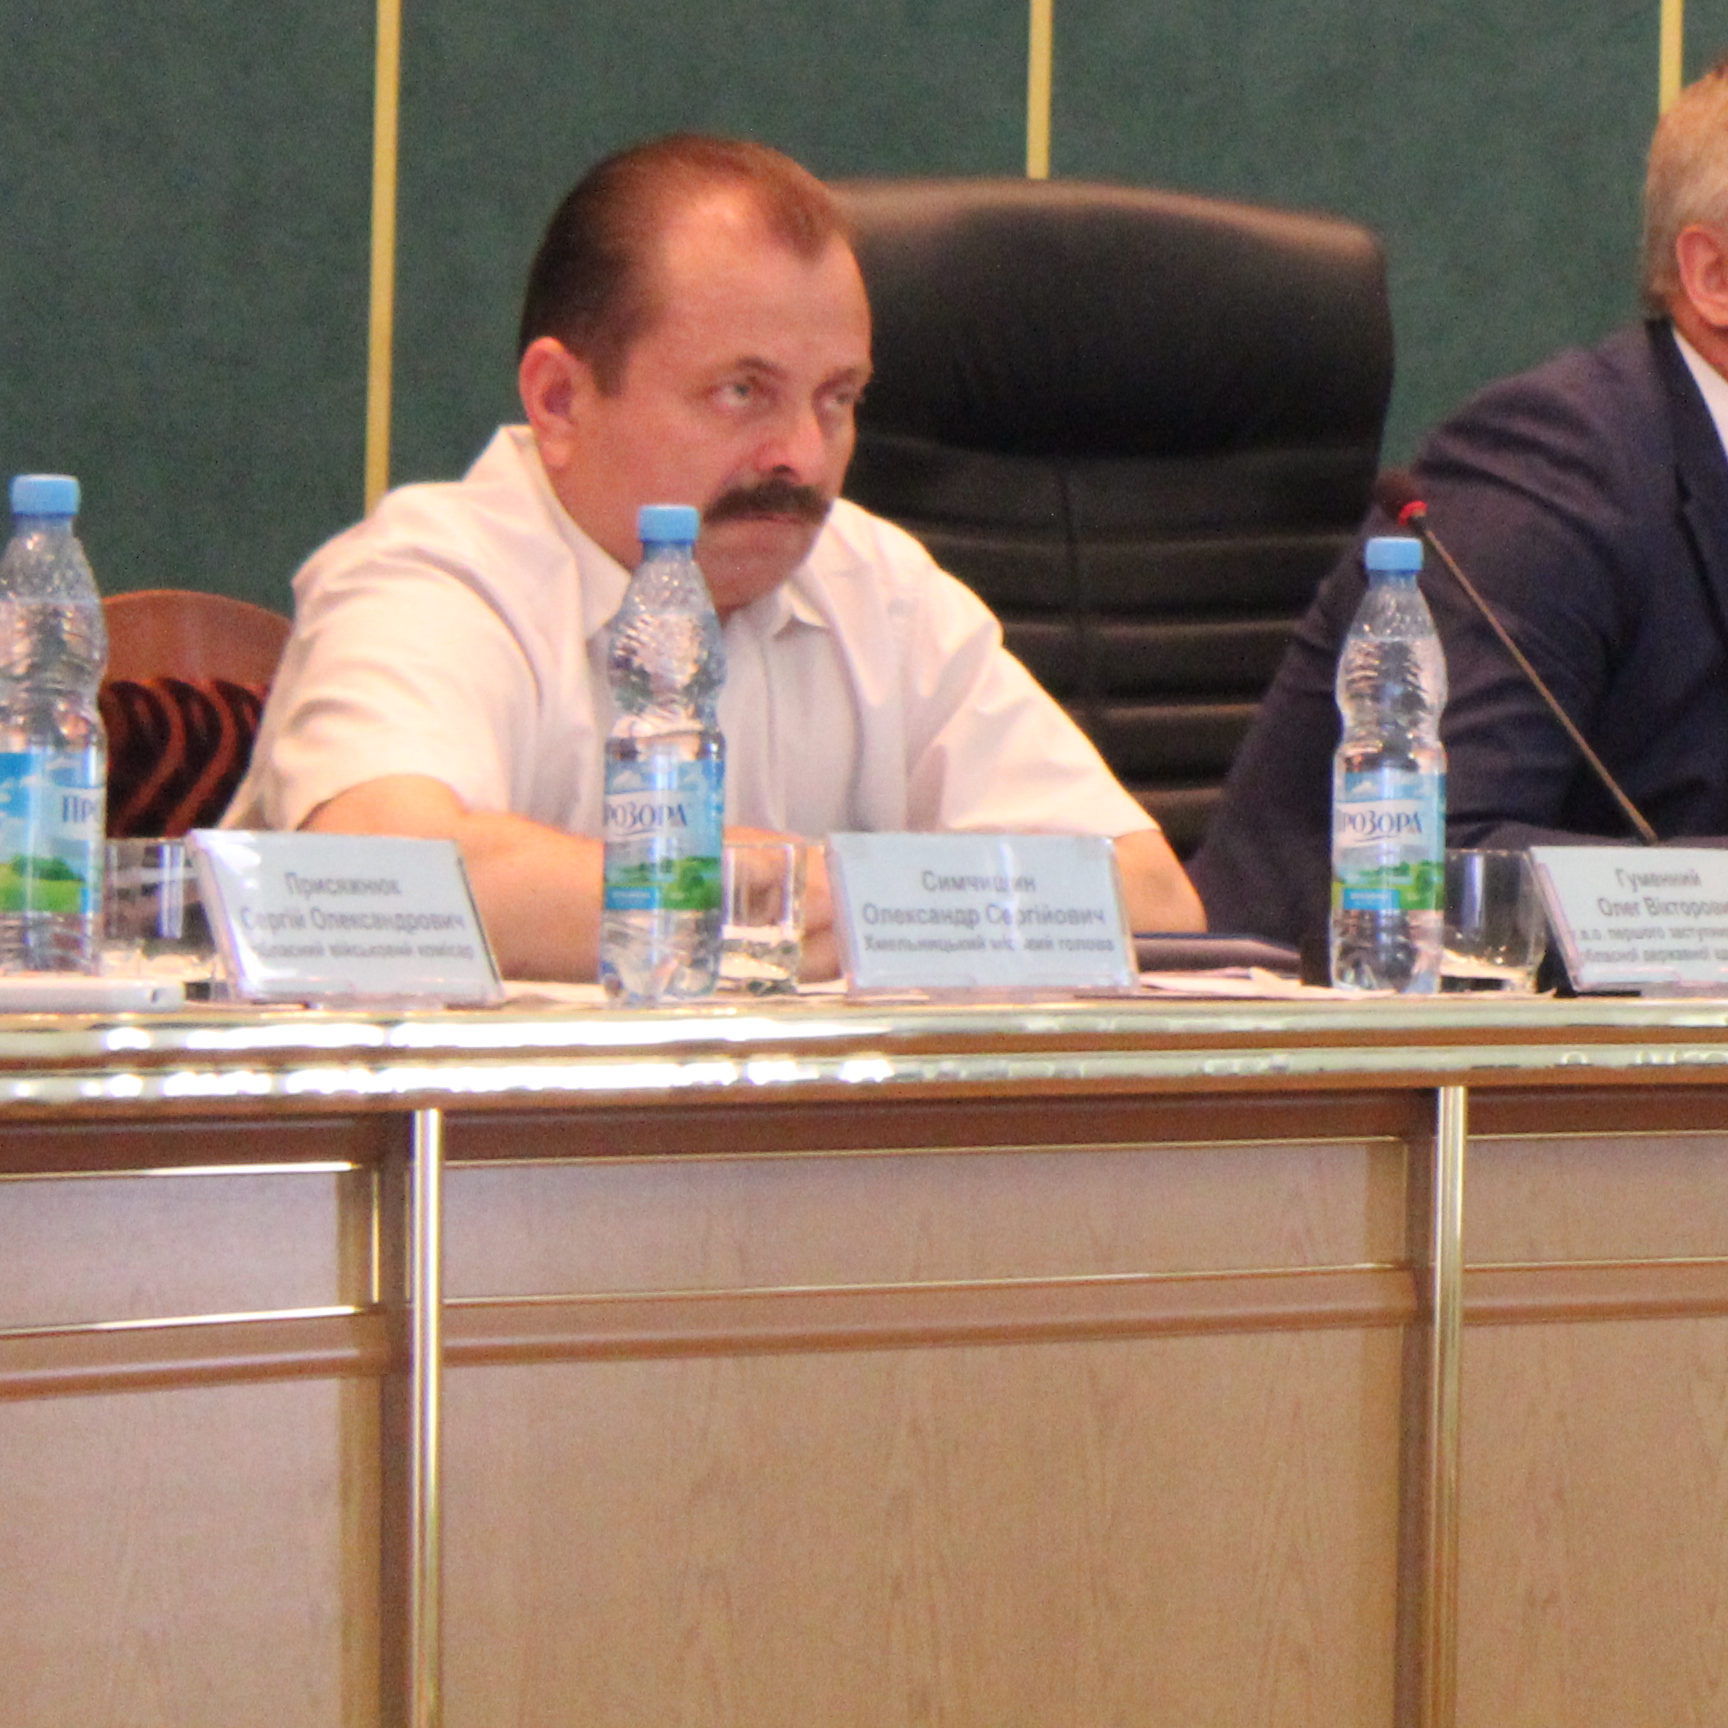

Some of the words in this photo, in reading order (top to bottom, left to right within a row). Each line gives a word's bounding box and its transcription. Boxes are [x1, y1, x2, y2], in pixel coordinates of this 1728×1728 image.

[310, 906, 465, 934] Олександрович
[862, 903, 981, 929] Олександр
[1597, 897, 1640, 917] Олег
